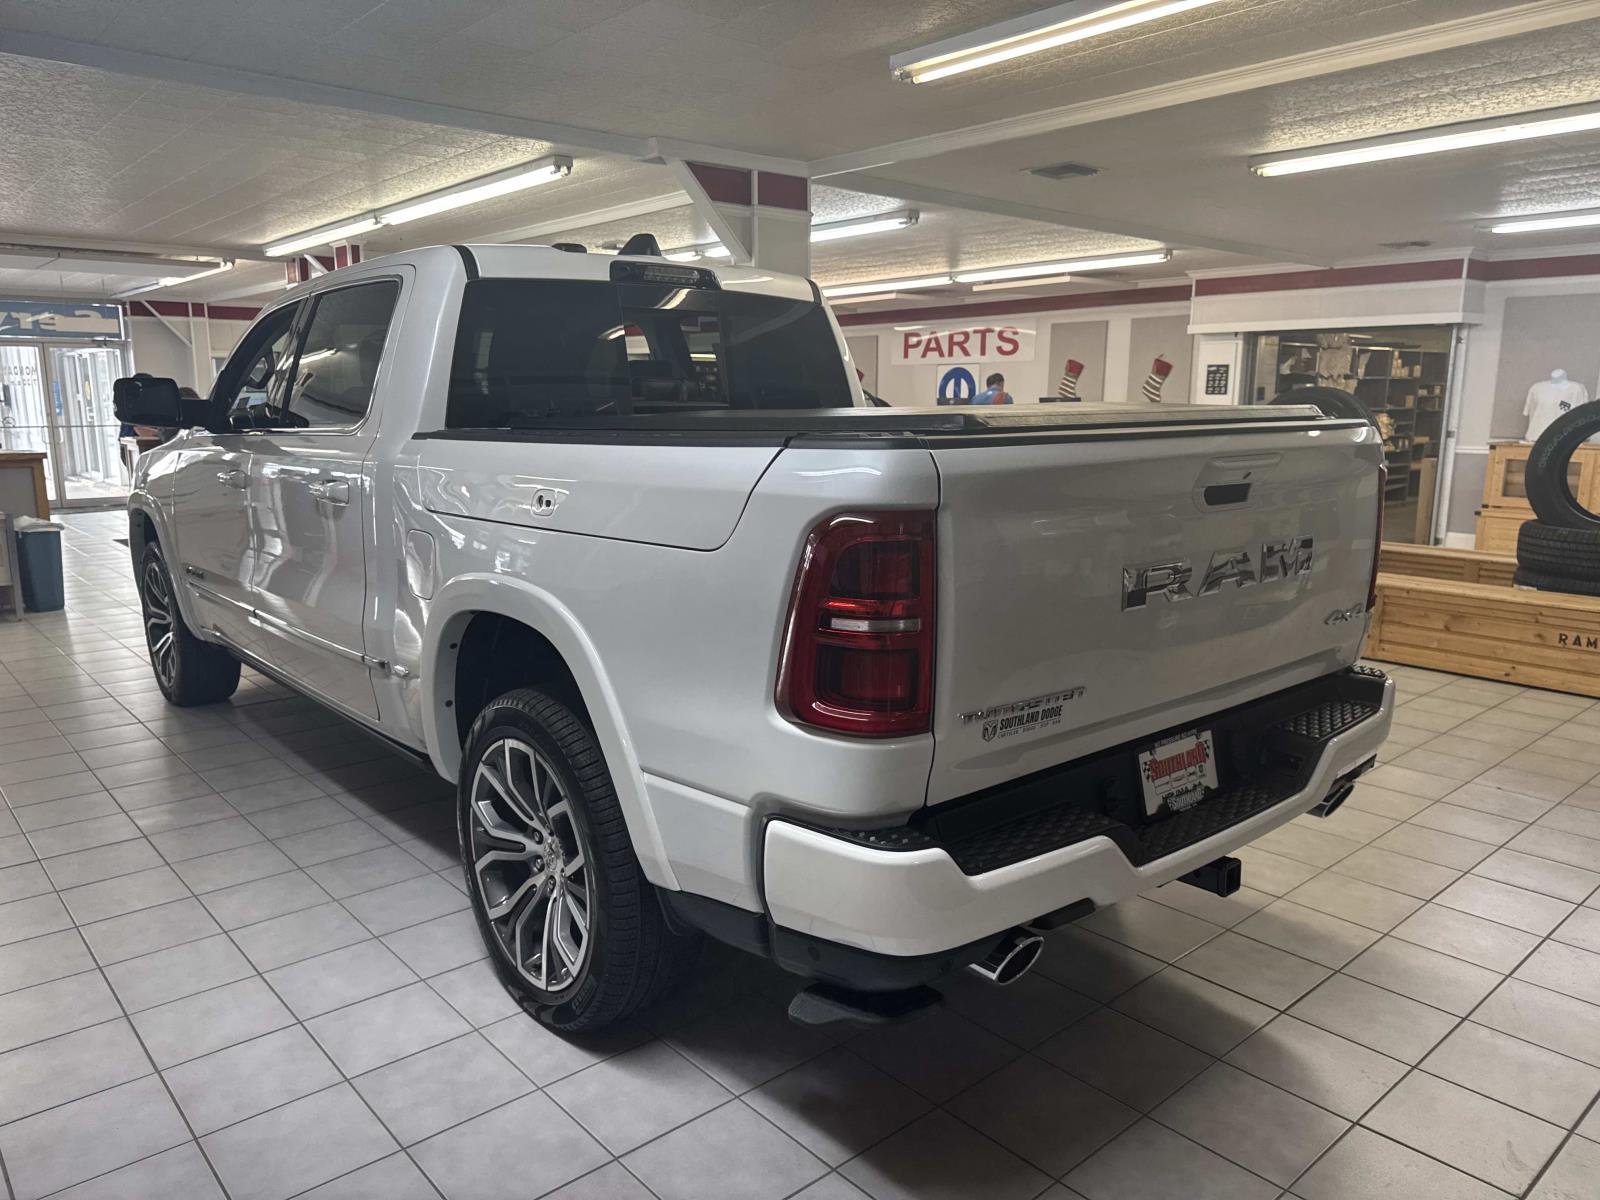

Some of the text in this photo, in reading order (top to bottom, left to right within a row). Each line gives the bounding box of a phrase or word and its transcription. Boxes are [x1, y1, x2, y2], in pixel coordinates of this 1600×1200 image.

[903, 326, 1020, 360] PARTS
[1122, 535, 1313, 612] RAM
[1558, 632, 1598, 649] RAM
[999, 705, 1063, 731] SOUTHLAND DODGE
